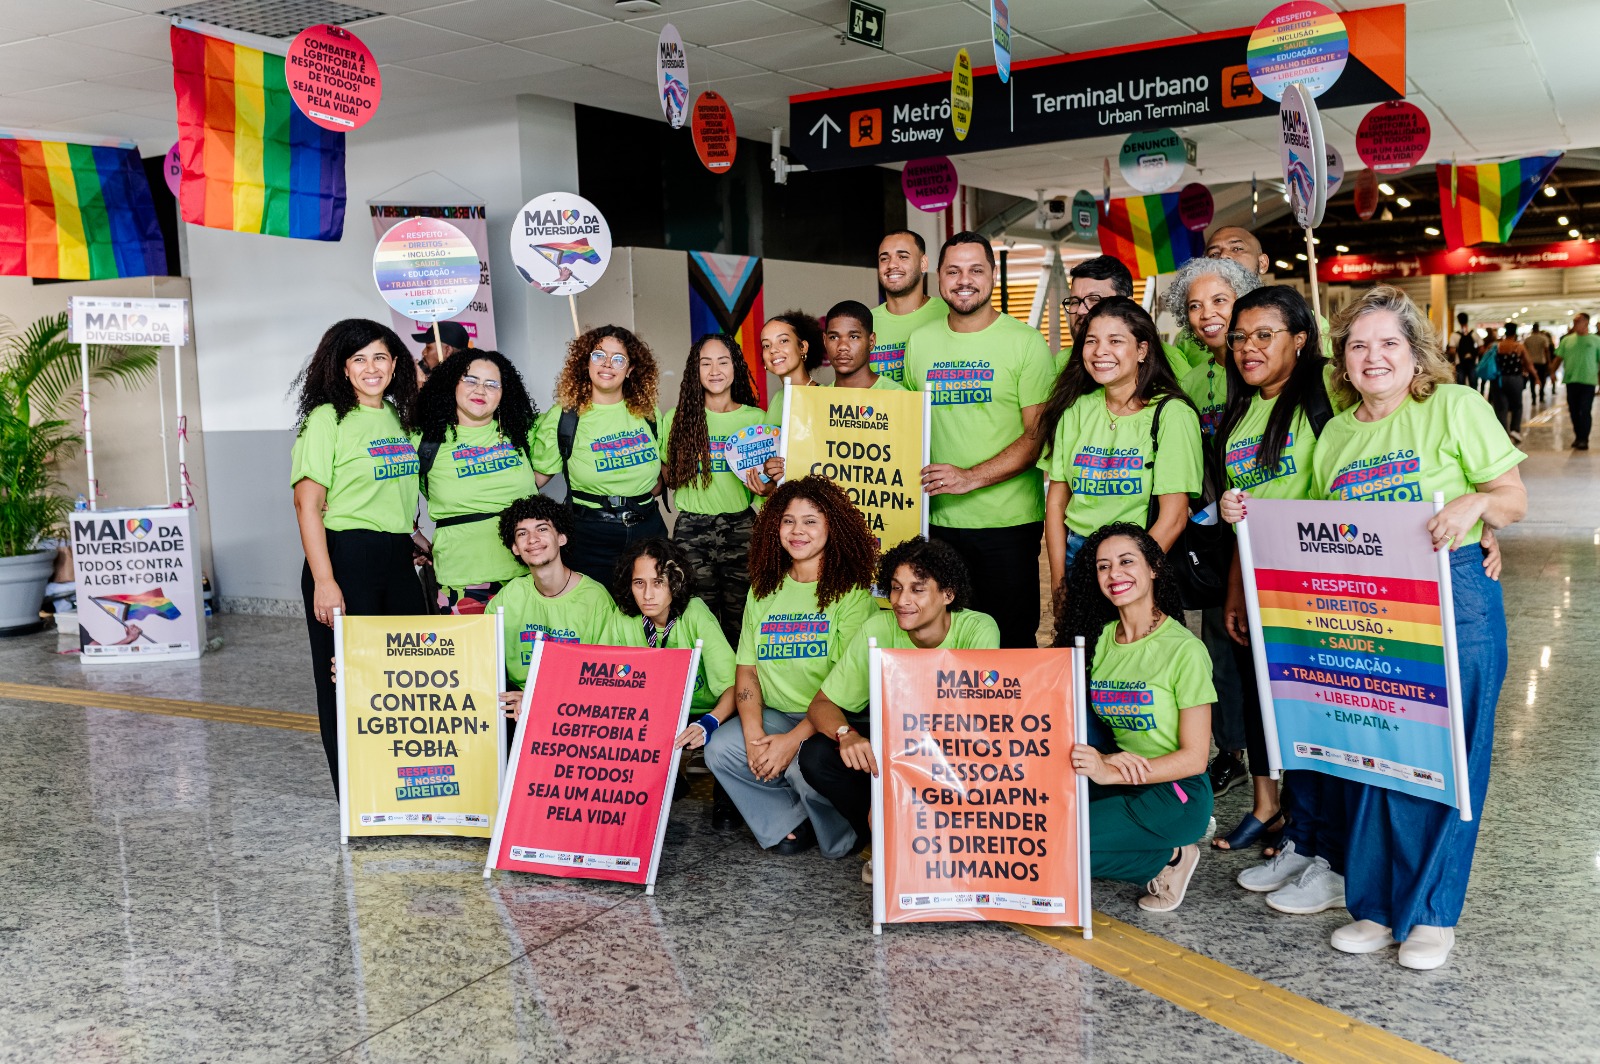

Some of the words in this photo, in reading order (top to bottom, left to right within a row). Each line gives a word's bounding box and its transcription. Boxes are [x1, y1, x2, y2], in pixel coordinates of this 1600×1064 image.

[1276, 10, 1311, 24] RESPEITO
[1278, 21, 1311, 32] DIREITOS
[1277, 29, 1313, 42] INCLUSÃO
[305, 38, 356, 60] COMBATER
[358, 54, 365, 64] A
[1277, 47, 1317, 61] EDUCAÇÃO
[304, 48, 357, 71] LGBTFOBIA
[1261, 61, 1300, 74] TRABALHO
[1301, 53, 1335, 64] DECENTE
[292, 56, 375, 87] RESPONSALIDADE
[1278, 67, 1318, 80] LIBERDADE
[309, 71, 321, 82] DE
[324, 75, 360, 93] TODOS!
[293, 81, 314, 93] SEJA
[317, 87, 332, 98] UM
[334, 92, 371, 109] ALIADO
[1032, 82, 1124, 114] Terminal
[1129, 75, 1209, 100] Urbano
[308, 95, 330, 109] PELA
[333, 102, 358, 116] VIDA!
[893, 98, 951, 124] Metrô
[1098, 110, 1142, 125] Urban
[1144, 98, 1209, 120] Terminal
[1369, 114, 1409, 123] COMBATER
[891, 127, 944, 143] Subway
[1284, 131, 1310, 149] DIVERSIDADE
[1124, 137, 1178, 154] DENUNCIE!
[1393, 144, 1423, 152] ALIADO
[907, 163, 948, 177] NENHUM
[906, 176, 944, 189] DIREITO
[916, 187, 949, 198] MENOS
[583, 215, 599, 224] DA
[525, 224, 600, 236] DIVERSIDADE
[408, 250, 445, 258] INCLUSÃO
[408, 268, 449, 278] EDUCAÇÃO
[392, 279, 432, 288] TRABALHO
[152, 323, 169, 331] DA
[86, 332, 170, 342] DIVERSIDADE
[933, 360, 990, 368] MOBILIZAÇÃO
[927, 369, 992, 379] #RESPEITO
[936, 381, 942, 390] É
[946, 380, 980, 389] NOSSO
[829, 419, 888, 430] DIVERSIDADE
[876, 412, 888, 422] DA
[826, 441, 890, 462] TODOS
[1074, 454, 1142, 468] #RESPEITO
[811, 463, 886, 484] CONTRA
[891, 469, 903, 487] A
[1082, 467, 1089, 478] É
[1092, 469, 1129, 479] NOSSO
[1072, 478, 1141, 494] DIREITO!
[159, 526, 182, 537] DA
[1362, 533, 1381, 544] DA
[76, 540, 184, 554] DIVERSIDADE
[1300, 543, 1383, 556] DIVERSIDADE
[78, 561, 122, 571] TODOS
[127, 558, 183, 570] CONTRA
[84, 576, 92, 585] A
[95, 572, 178, 585] LGBT+FOBIA
[1312, 579, 1377, 595] RESPEITO
[1316, 598, 1377, 614] DIREITOS
[768, 612, 826, 621] MOBILIZAÇÃO
[762, 622, 828, 632] #RESPEITO
[1316, 617, 1382, 634] INCLUSÃO
[770, 634, 775, 644] É
[779, 633, 816, 642] NOSSO
[1329, 636, 1375, 652] SAÚDE
[758, 643, 825, 657] DIREITO!
[1318, 654, 1391, 674] EDUCAÇÃO
[384, 670, 459, 688] TODOS
[633, 671, 646, 679] DA
[1003, 677, 1021, 688] DA
[579, 678, 646, 688] DIVERSIDADE
[1292, 668, 1361, 688] TRABALHO
[1364, 678, 1426, 700] DECENTE
[937, 689, 1021, 700] DIVERSIDADE
[1323, 691, 1396, 713] LIBERDADE
[371, 694, 456, 711] CONTRA
[462, 694, 476, 711] A
[557, 703, 636, 721] COMBATER
[640, 708, 649, 722] A
[358, 717, 489, 734] LGBTQIAPN+
[903, 714, 1014, 733] DEFENDER
[1021, 714, 1052, 732] OS
[1335, 711, 1390, 731] EMPATIA
[552, 723, 634, 741] LGBTFOBIA
[638, 724, 646, 741] É
[393, 740, 458, 757] FOBIA
[531, 742, 660, 764] RESPONSALIDADE
[904, 738, 1002, 757] DIREITOS
[1009, 738, 1050, 758] DAS
[398, 766, 454, 777] RESPEITO
[554, 765, 575, 778] DE
[577, 766, 633, 783] TODOS!
[932, 763, 1024, 782] PESSOAS
[406, 777, 412, 786] É
[416, 776, 449, 785] NOSSO
[397, 783, 459, 798] DIREITO!
[528, 783, 560, 799] SEJA
[564, 786, 588, 800] UM
[591, 788, 648, 805] ALIADO
[912, 787, 1049, 806] LGBTQIAPN+
[547, 806, 585, 822] PELA
[587, 809, 626, 826] VIDA!
[917, 806, 927, 830] É
[935, 812, 1047, 832] DEFENDER
[912, 836, 942, 854] OS
[950, 836, 1047, 857] DIREITOS
[926, 861, 1039, 882] HUMANOS
